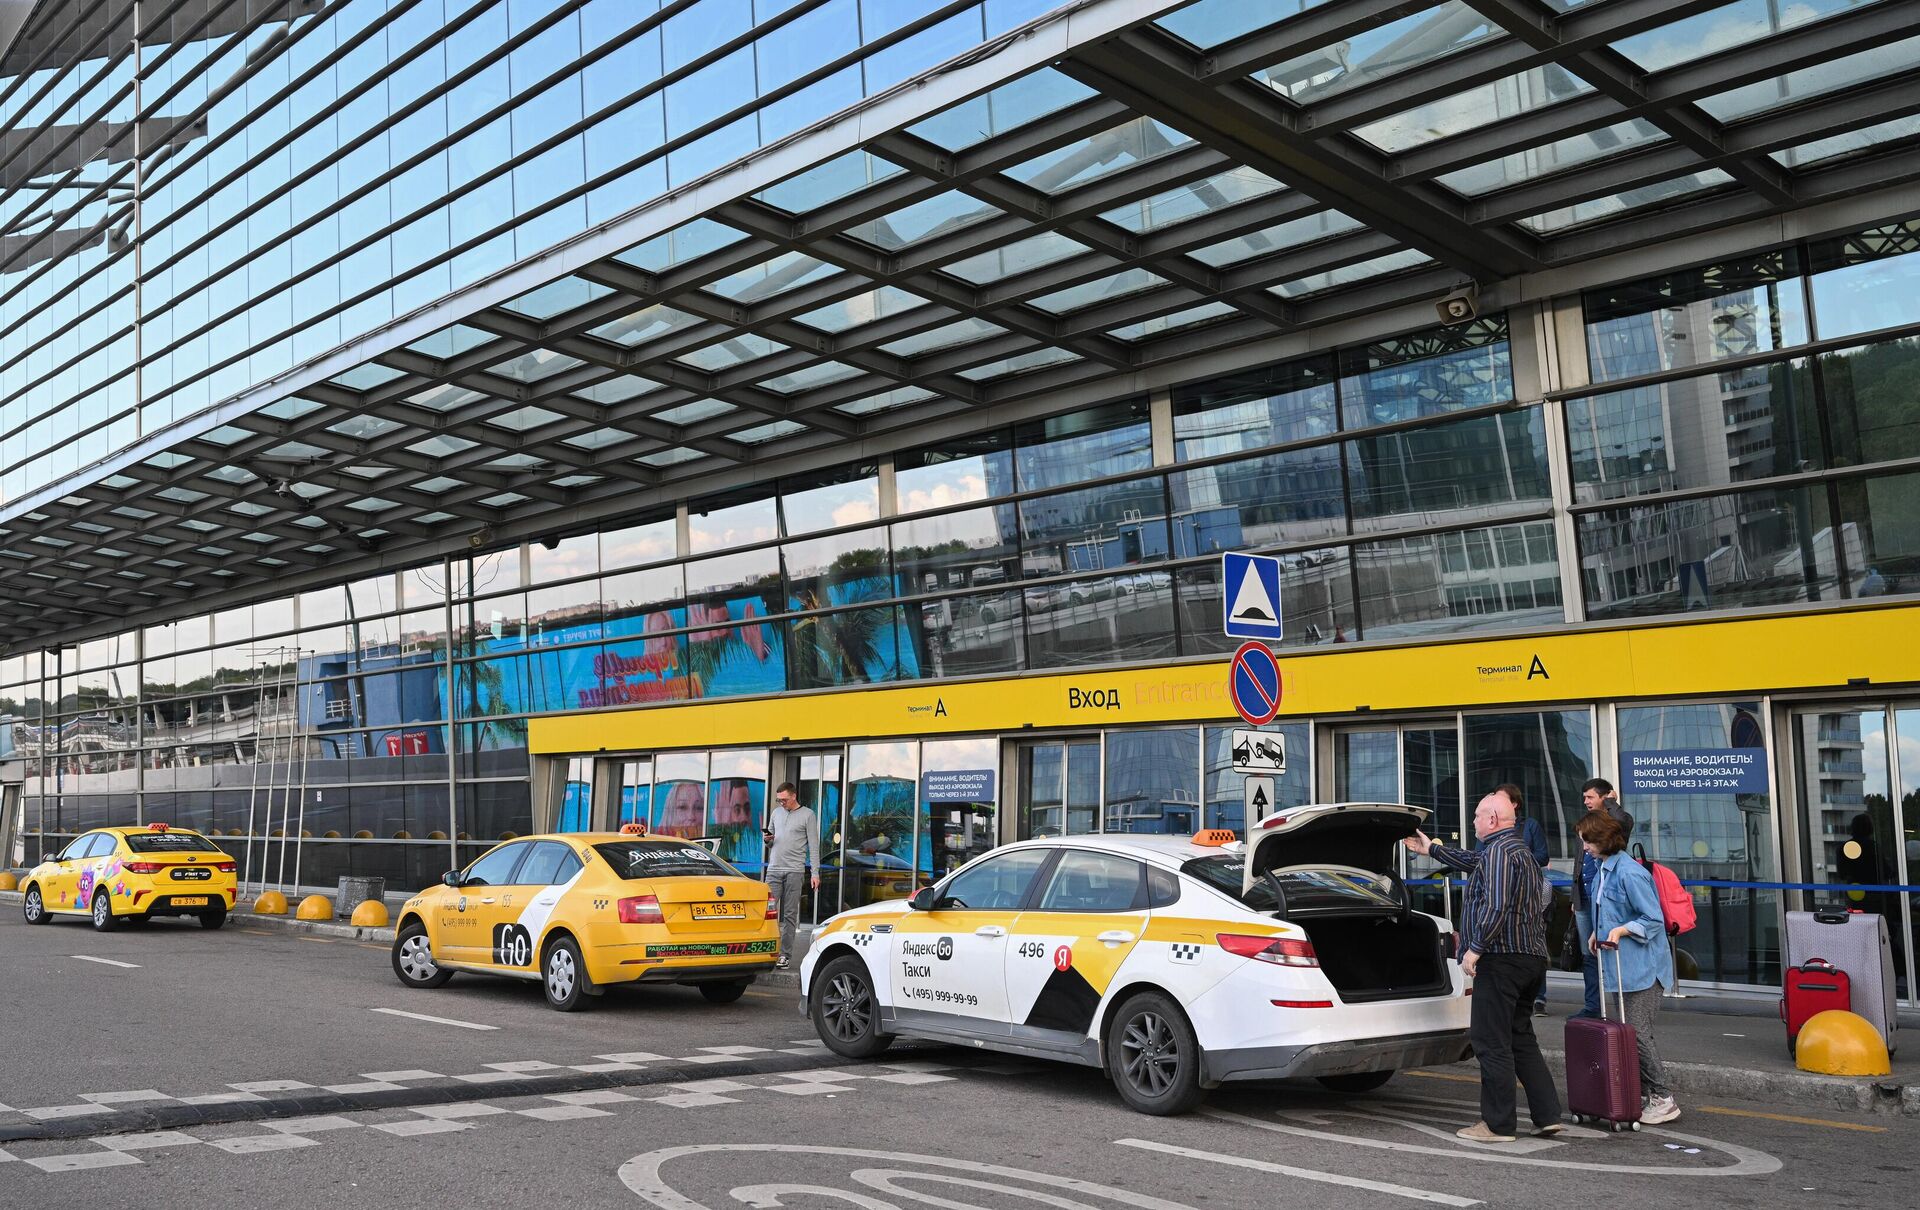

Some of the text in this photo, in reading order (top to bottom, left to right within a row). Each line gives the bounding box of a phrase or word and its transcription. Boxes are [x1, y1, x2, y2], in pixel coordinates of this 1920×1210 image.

[1476, 663, 1522, 676] Терминал
[1068, 687, 1121, 710] Вход
[907, 705, 932, 713] Терминал
[1633, 754, 1753, 766] ВНИМАНИЕ, ВОДИТЕЛЬ!
[1633, 767, 1744, 777] ВЫХОД ИЗ АЭРОВОКЗАЛА
[1634, 779, 1739, 788] ТОЛЬКО ЧЕРЕЗ 1-й ЭТАЖ
[629, 849, 685, 861] Яндекс
[695, 903, 741, 915] ВК 155 99
[501, 924, 526, 966] Go
[647, 944, 679, 952] РАБОТАЙ
[902, 940, 951, 956] Яндекс Go
[1018, 942, 1045, 958] 496
[1058, 949, 1067, 967] Я
[902, 961, 931, 978] Такси
[912, 987, 978, 1006] (495) 999-99-99
